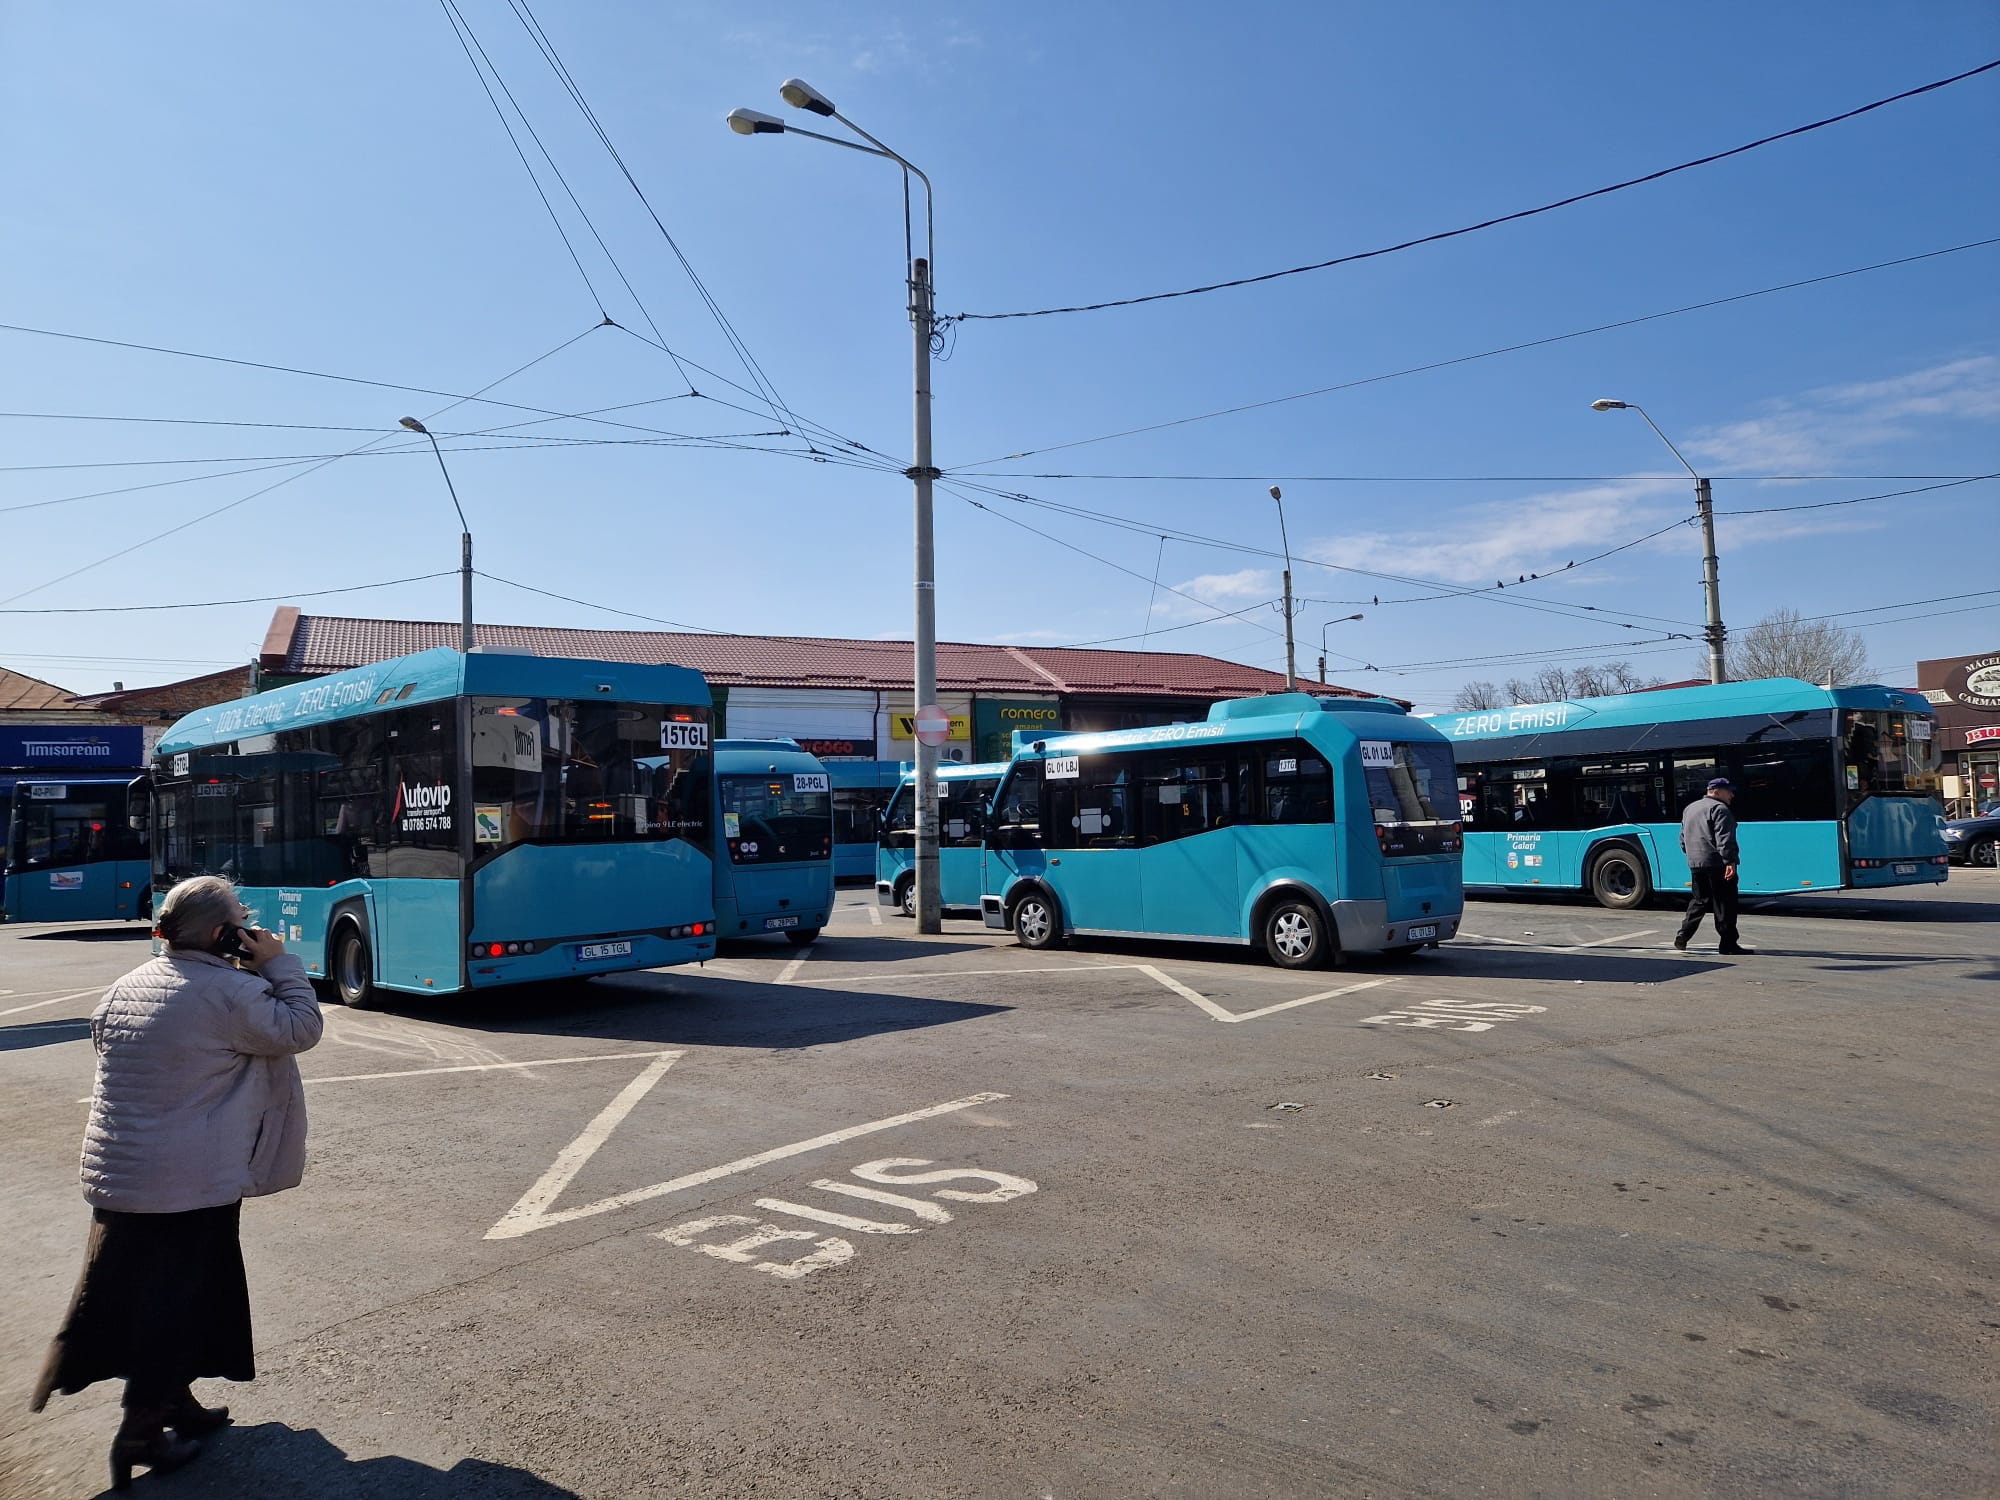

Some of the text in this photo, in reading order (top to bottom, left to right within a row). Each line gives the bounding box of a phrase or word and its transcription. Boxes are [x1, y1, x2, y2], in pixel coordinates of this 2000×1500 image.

[215, 706, 242, 734] 100%
[294, 686, 330, 716] ZERO
[331, 672, 376, 708] Emisii
[1000, 708, 1057, 720] romero
[1454, 706, 1568, 736] ZERO Emisii
[662, 724, 707, 747] 15TGL
[1148, 727, 1184, 742] ZERO
[1187, 723, 1226, 738] Emisii
[1362, 747, 1392, 760] GL 01 LBJ
[1047, 760, 1078, 774] GL 01 LBJ
[796, 777, 824, 790] 28-PGL
[396, 775, 451, 815] Autovip
[409, 816, 452, 831] 0786 574 788
[677, 819, 704, 828] electric
[584, 942, 629, 957] GL 15 TGL
[1359, 999, 1549, 1032] BUS
[653, 1157, 1039, 1278] BUS
